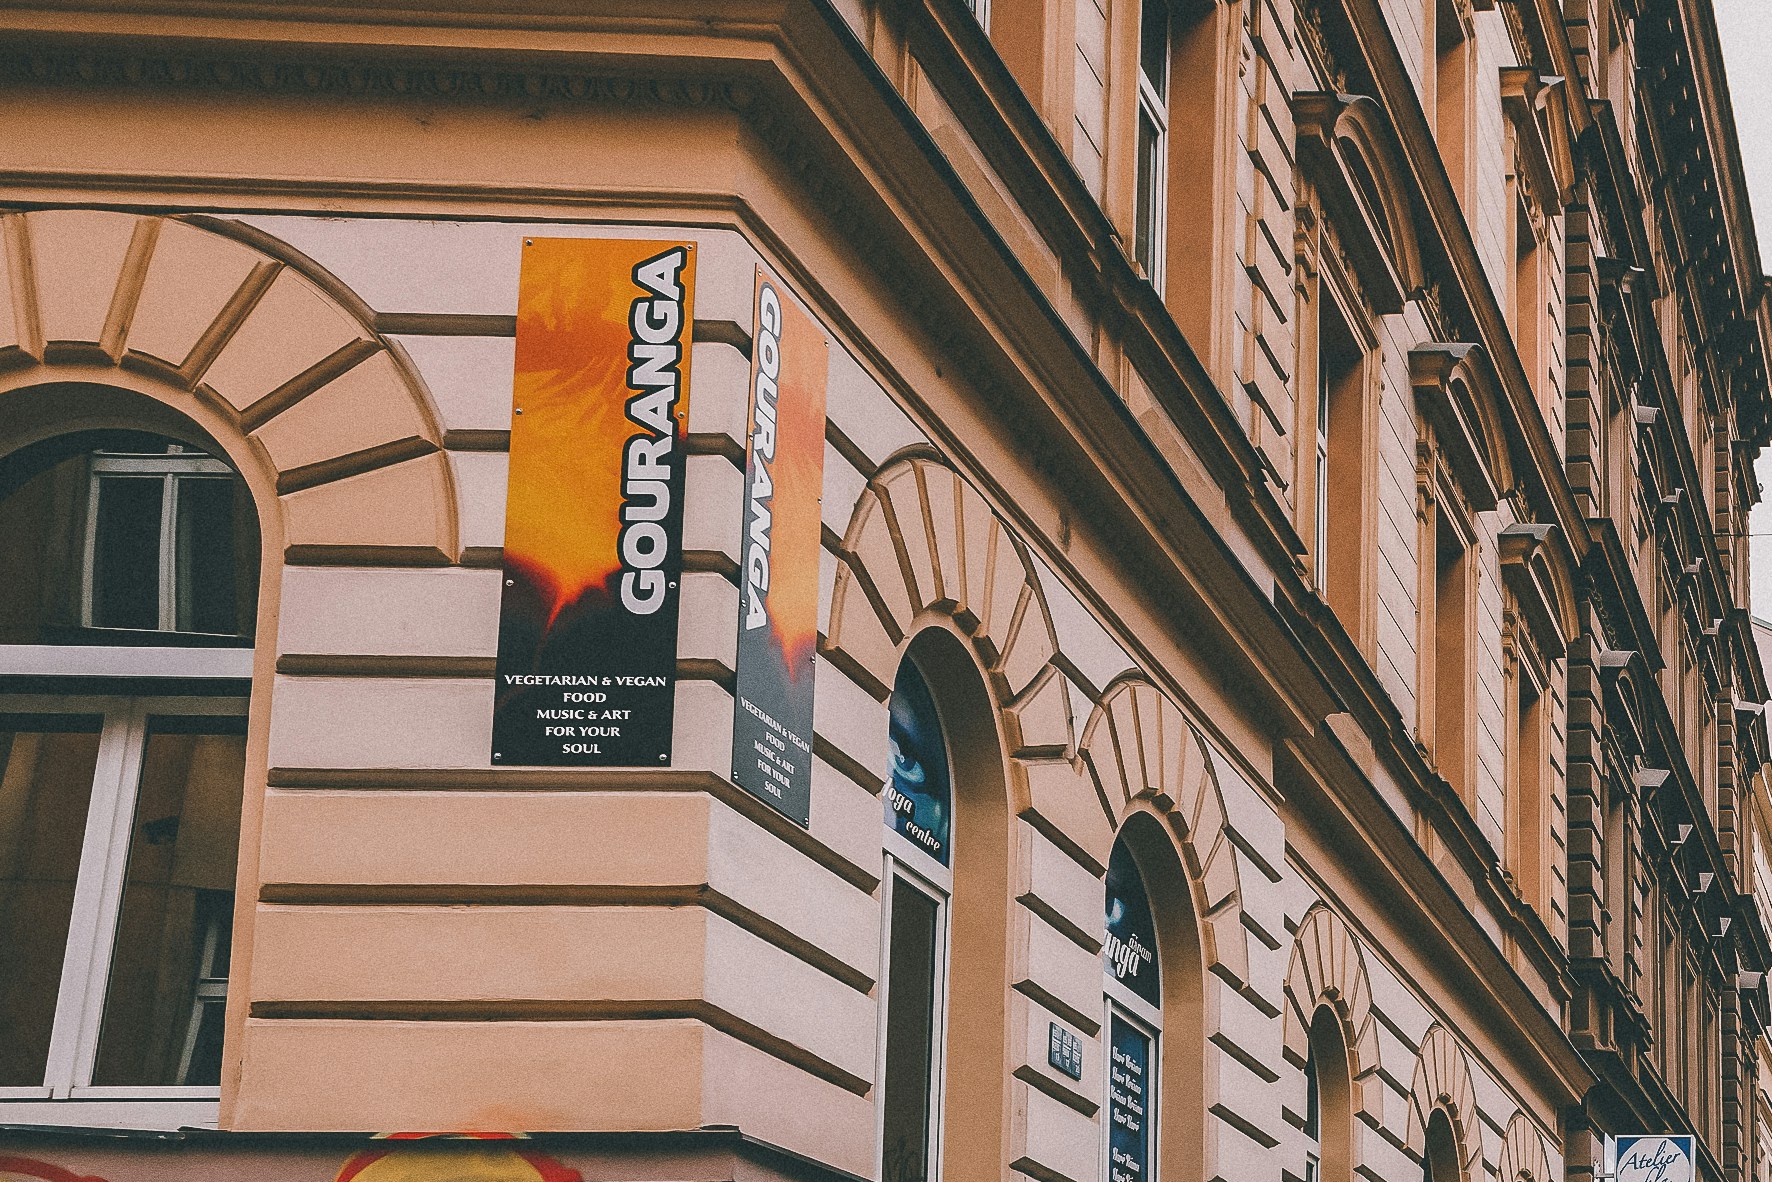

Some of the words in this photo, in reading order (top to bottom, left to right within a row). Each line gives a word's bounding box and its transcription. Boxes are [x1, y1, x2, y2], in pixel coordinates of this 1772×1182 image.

[620, 248, 684, 615] GOURANGA
[745, 282, 783, 631] GOURANGA
[504, 675, 598, 686] VEGETARIAN
[601, 676, 612, 686] &
[615, 676, 666, 687] VEGAN
[563, 692, 607, 703] FOOD
[536, 709, 585, 720] MUSIC
[587, 710, 598, 720] &
[600, 709, 632, 720] ART
[740, 696, 782, 734] VEGETARIAN
[787, 730, 810, 753] VEGAN
[545, 726, 576, 737] FOR
[579, 726, 621, 737] YOUR
[765, 731, 785, 752] FOOD
[562, 743, 602, 754] SOUL
[754, 739, 776, 762] MUSIC
[781, 759, 795, 775] ART
[757, 758, 772, 776] FOR
[771, 768, 791, 789] YOUR
[764, 780, 782, 800] SOUL
[1619, 1139, 1681, 1176] Atelier
